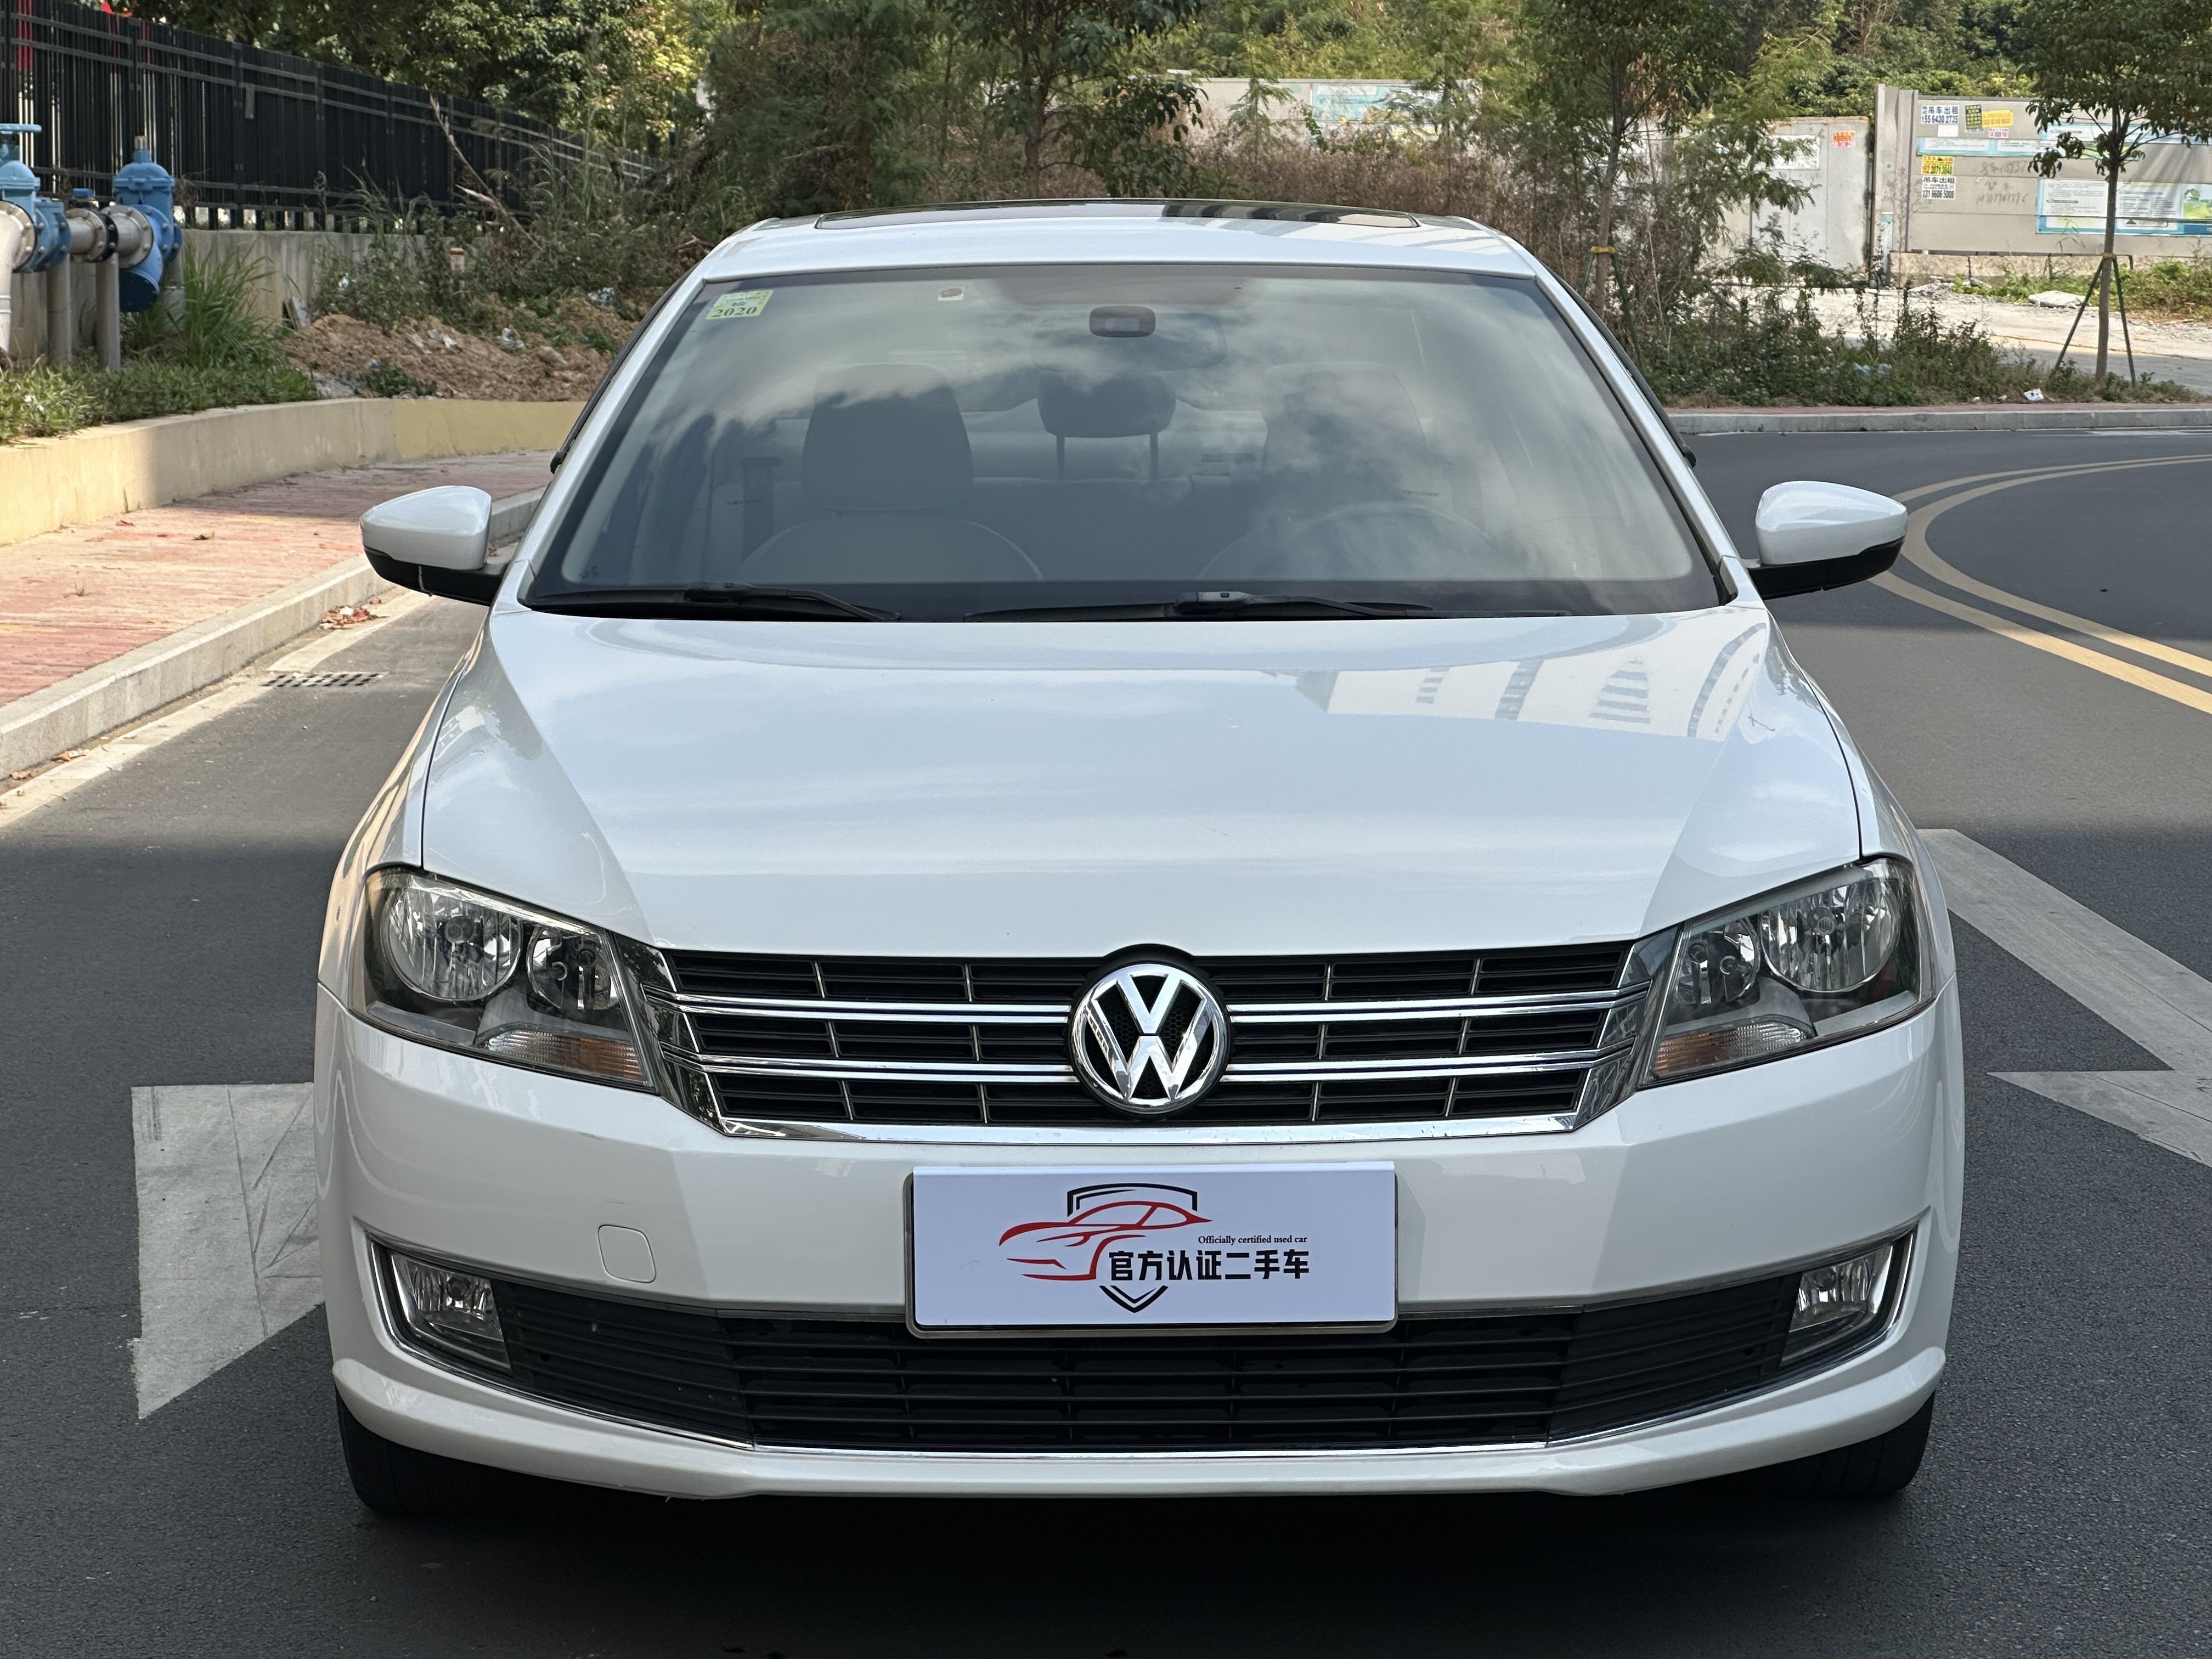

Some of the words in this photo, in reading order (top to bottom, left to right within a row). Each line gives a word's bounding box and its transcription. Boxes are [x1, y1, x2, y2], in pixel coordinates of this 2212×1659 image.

[1922, 115, 1931, 123] 155
[712, 307, 757, 317] 2020
[1073, 964, 1229, 1113] VW
[1198, 1235, 1235, 1245] Officially
[1238, 1235, 1272, 1243] certified
[1274, 1235, 1293, 1243] used
[1109, 1249, 1309, 1281] 官方认证二手车
